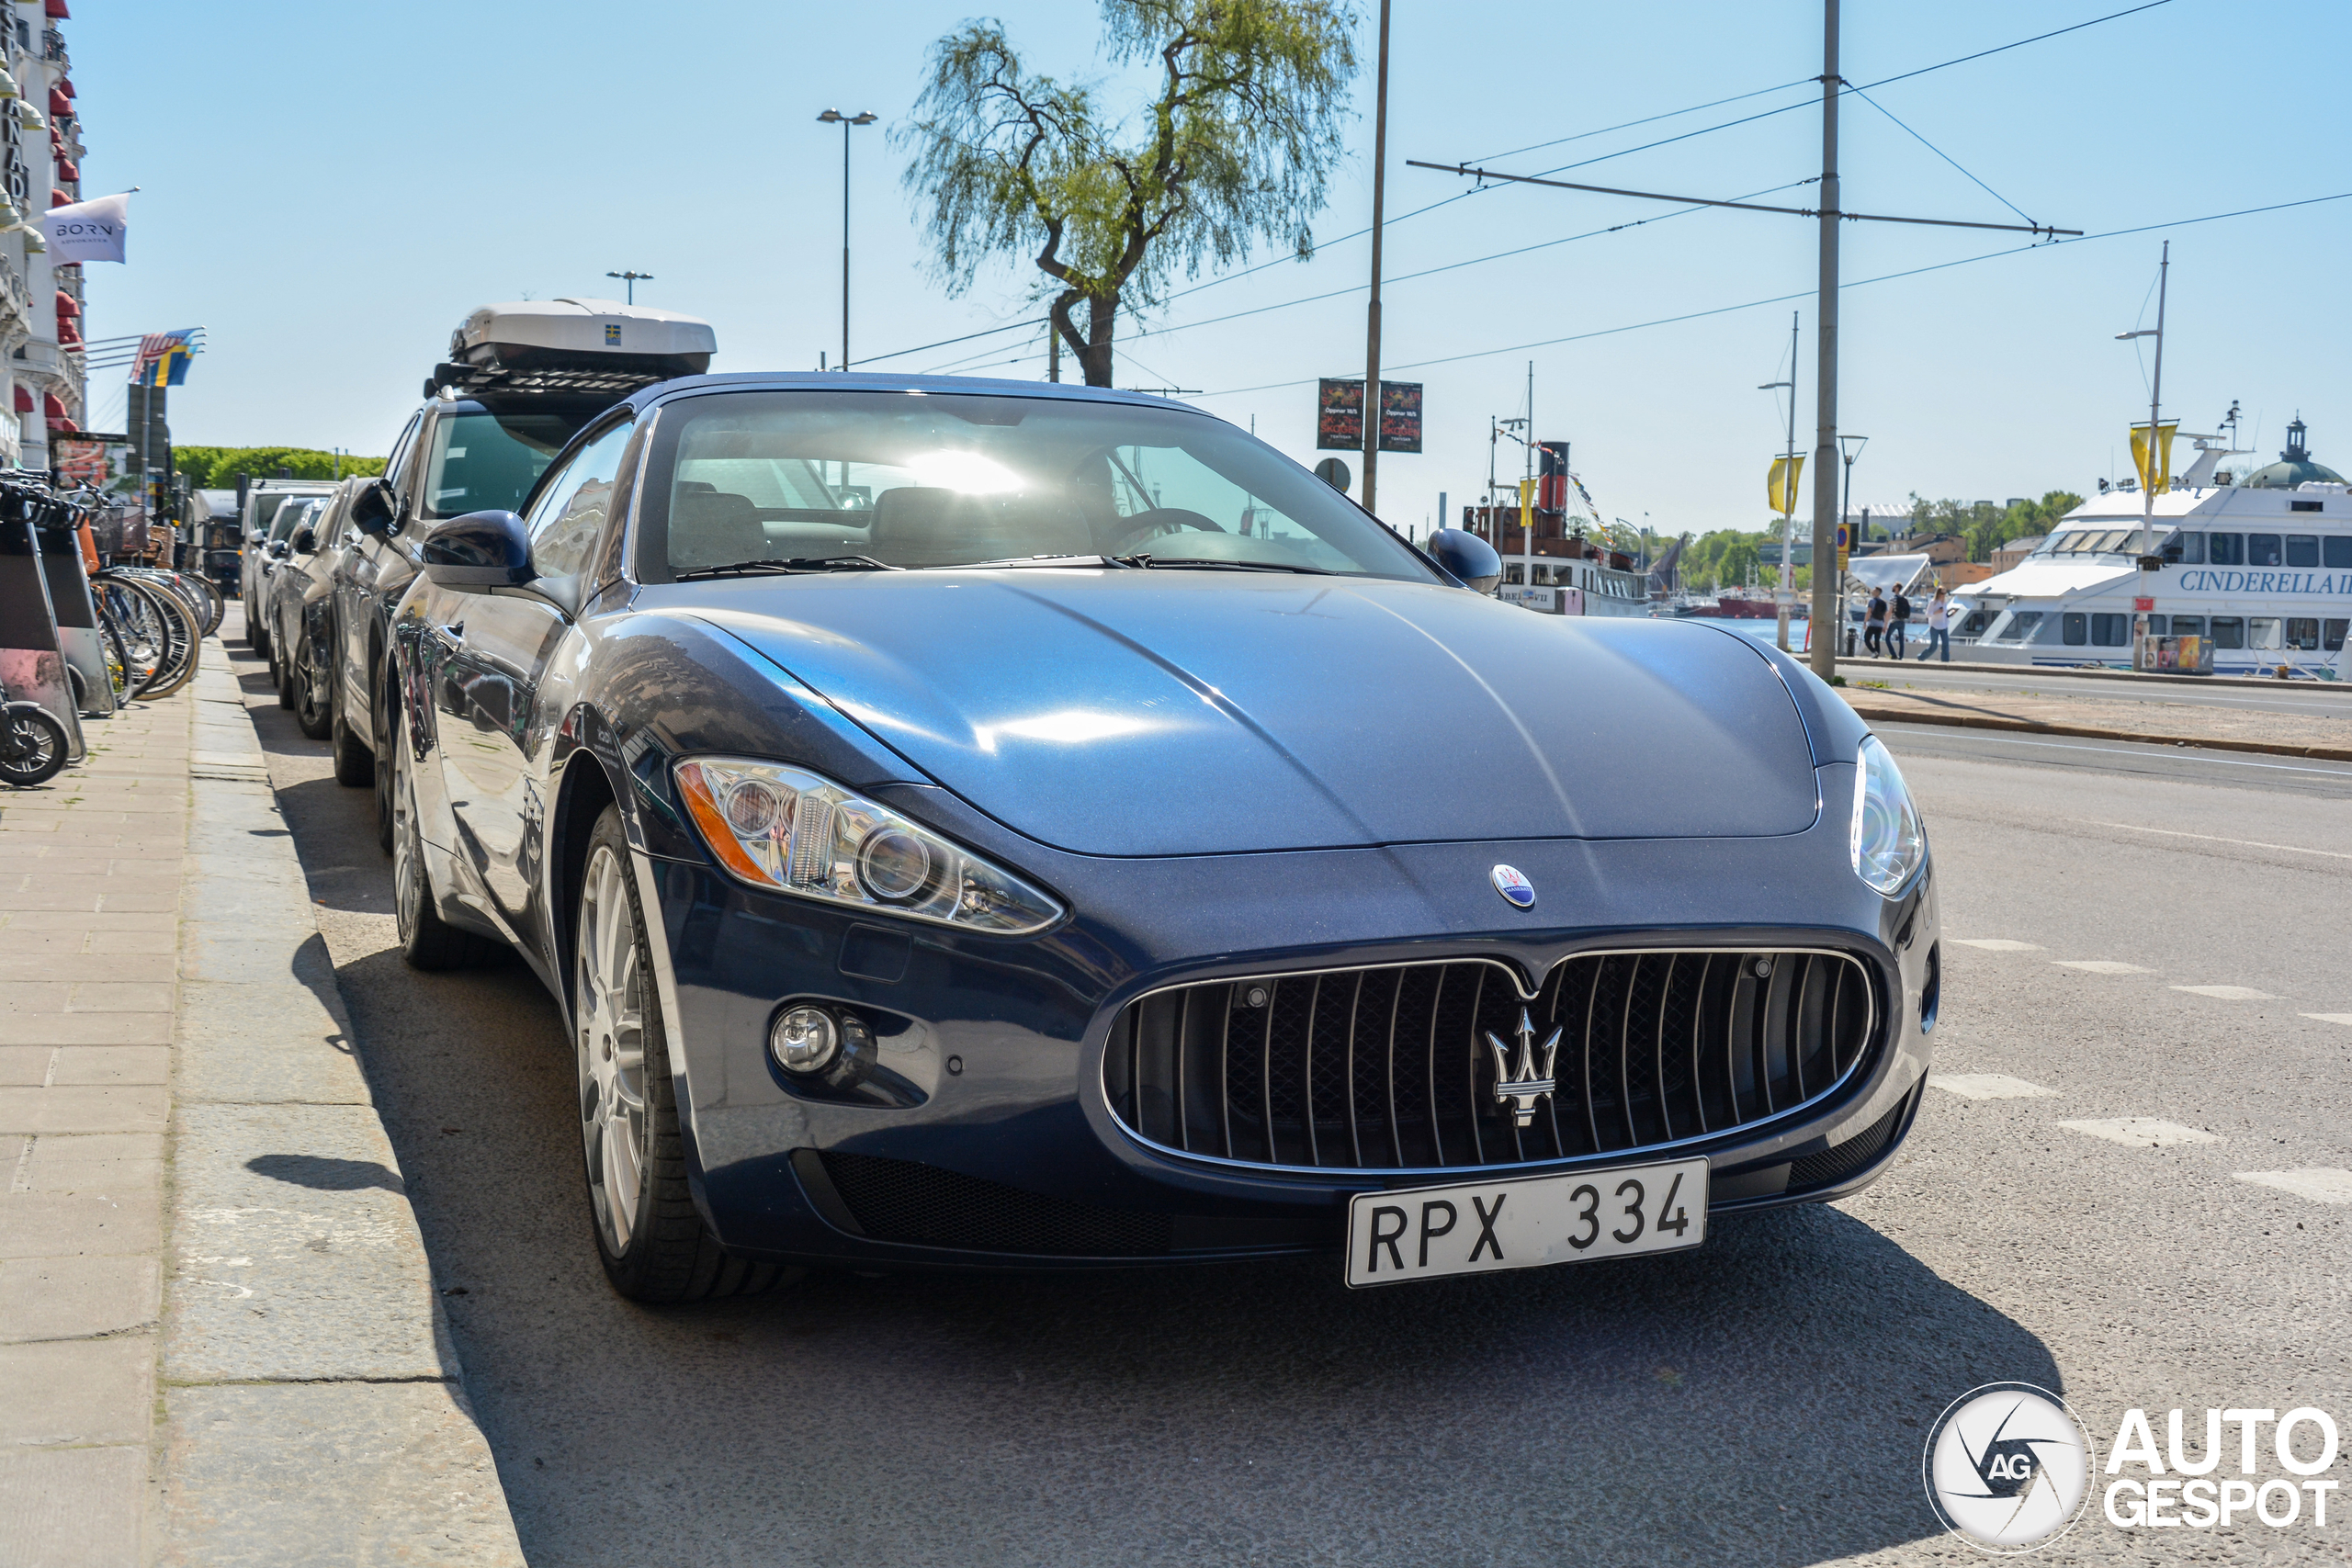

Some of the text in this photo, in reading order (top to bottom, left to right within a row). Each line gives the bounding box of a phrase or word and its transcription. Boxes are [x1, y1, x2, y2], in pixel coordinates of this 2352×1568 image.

[1325, 406, 1346, 414] Öppnar
[1385, 409, 1406, 417] Öppnar
[1320, 424, 1362, 434] SKOGEN
[1382, 426, 1420, 436] SKOGEN
[2180, 570, 2334, 594] CINDERELLA
[626, 860, 646, 963] MICHELIN
[1367, 1172, 1689, 1273] RPX 334
